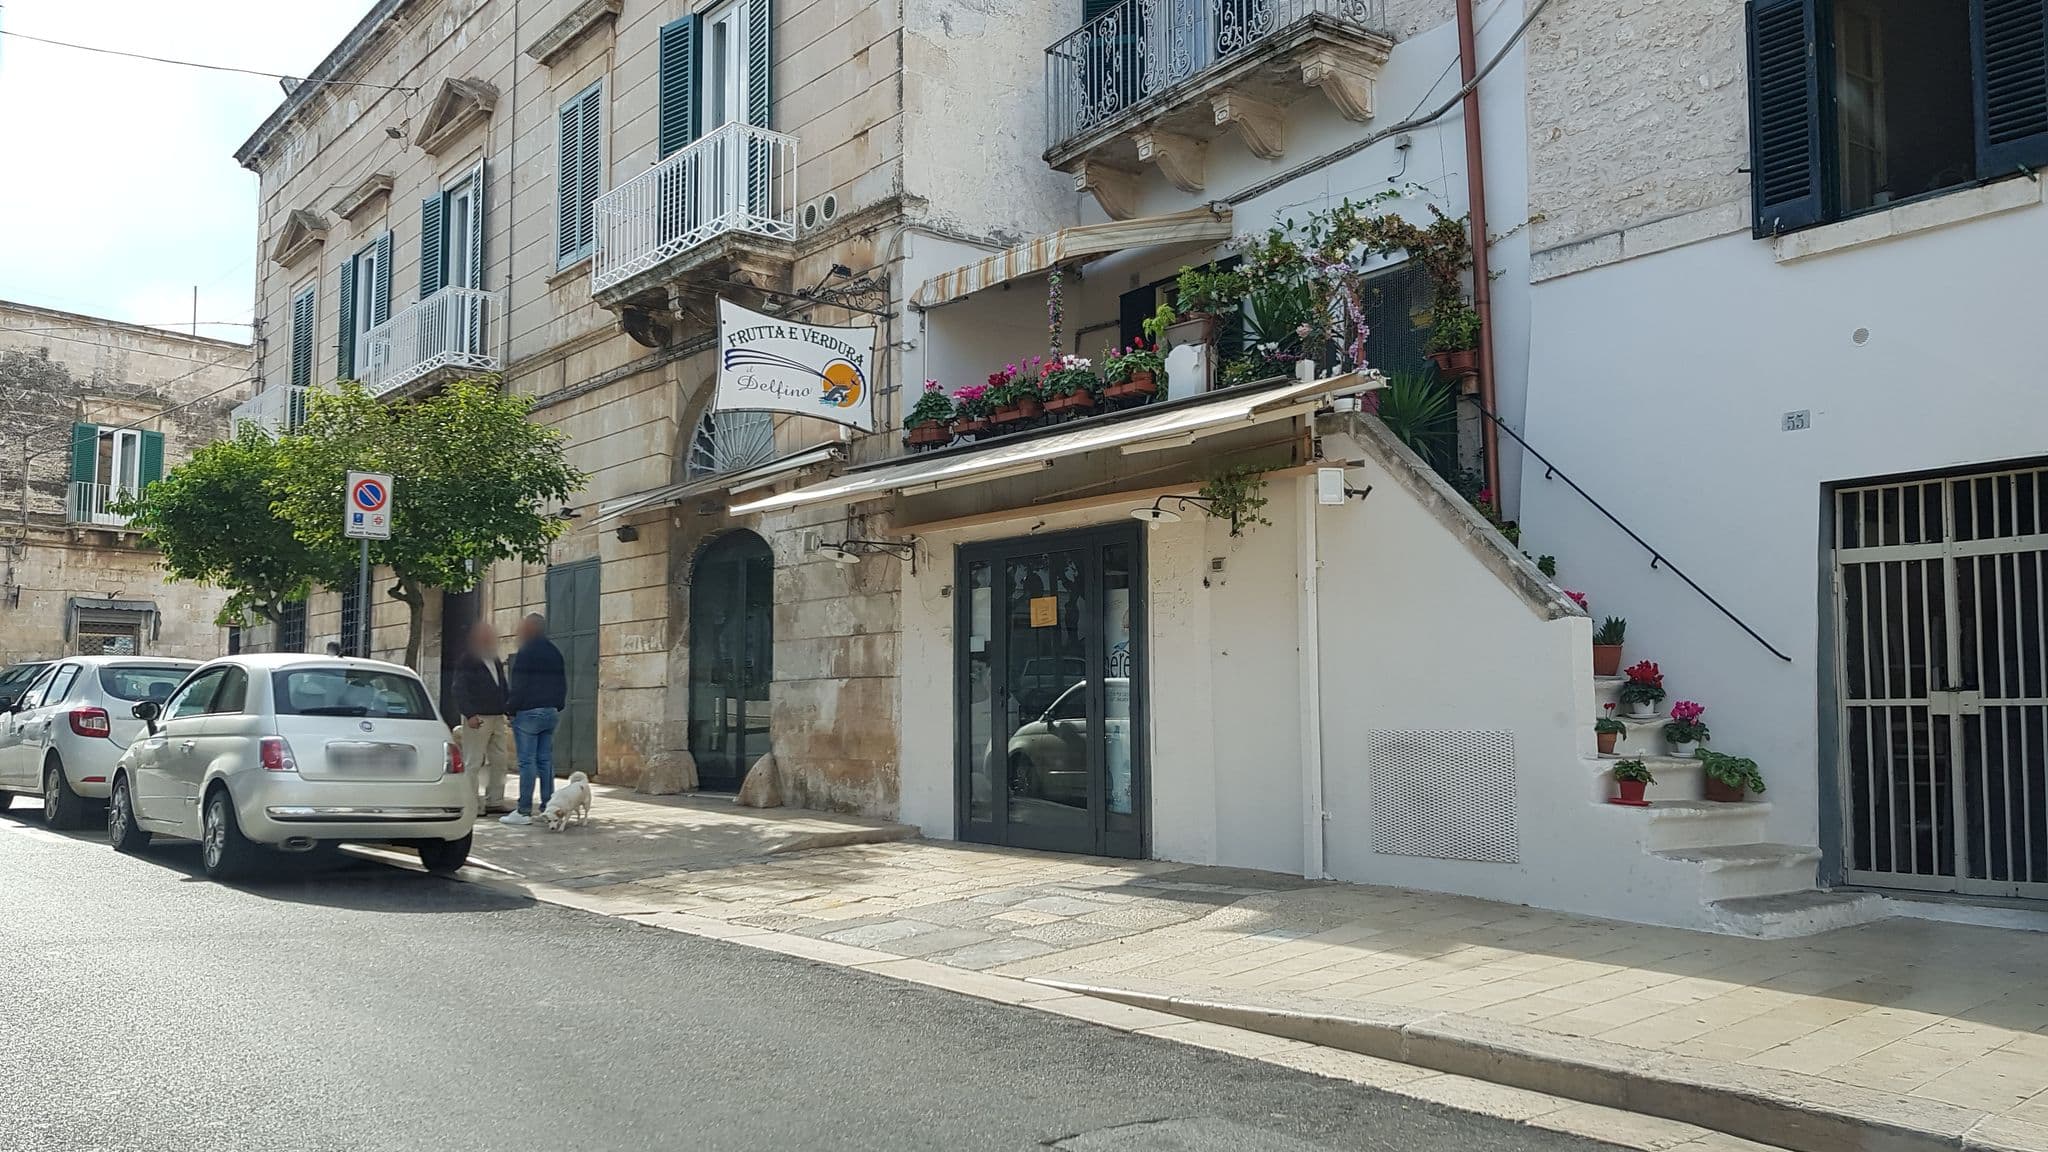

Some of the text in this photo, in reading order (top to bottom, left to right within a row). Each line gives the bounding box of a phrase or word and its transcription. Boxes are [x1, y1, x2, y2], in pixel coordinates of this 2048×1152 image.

[728, 325, 864, 368] FRUTTA E VERDURA
[737, 375, 811, 400] Delfino
